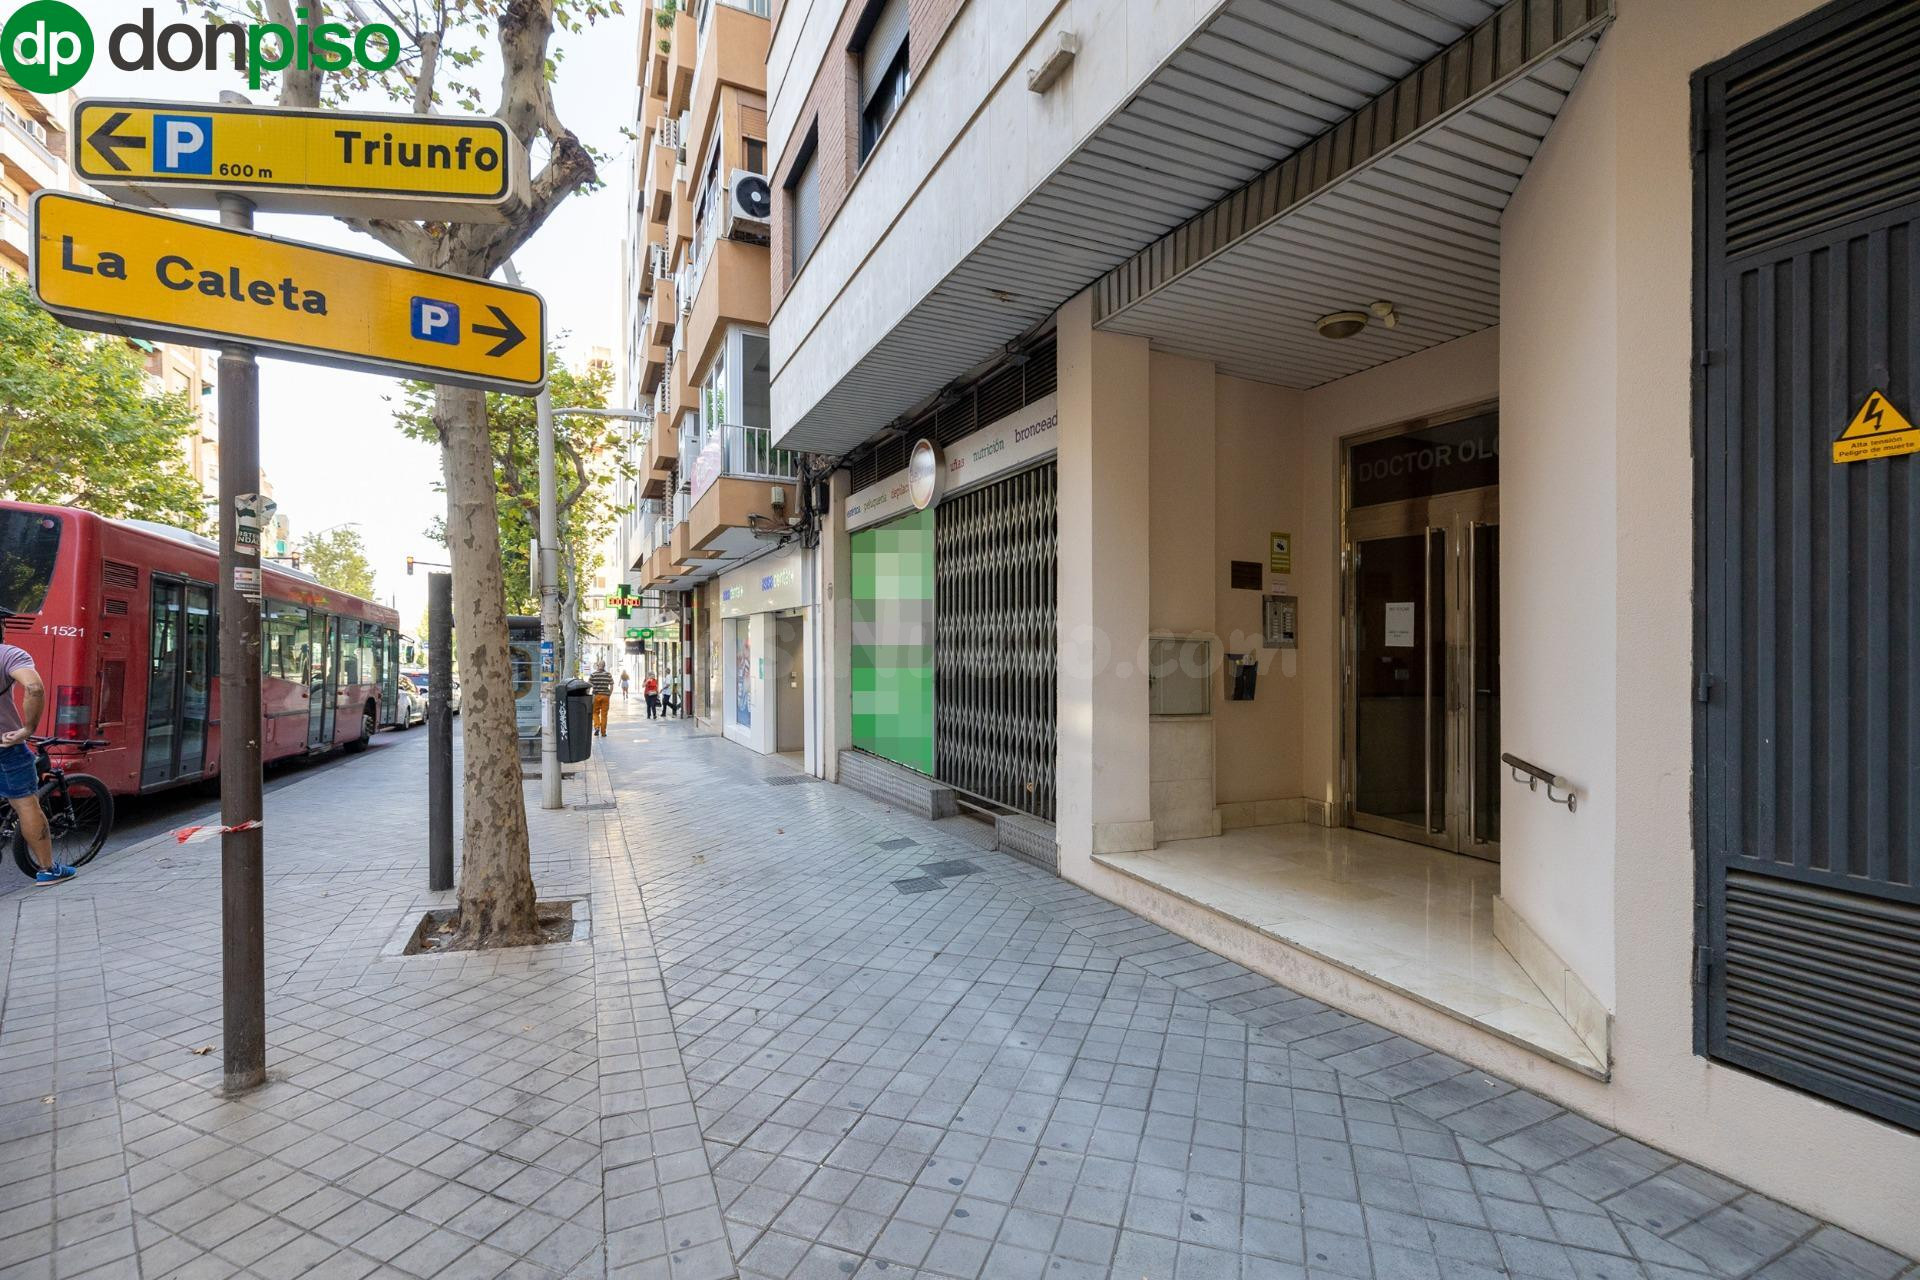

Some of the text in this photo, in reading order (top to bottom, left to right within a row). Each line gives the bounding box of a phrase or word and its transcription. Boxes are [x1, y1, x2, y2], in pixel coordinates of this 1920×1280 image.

[165, 121, 205, 168] P
[334, 130, 499, 171] Triunfo
[219, 163, 273, 179] 600 m
[61, 235, 328, 316] La Caleta
[421, 303, 449, 335] P
[973, 438, 1005, 462] nutrición
[1015, 409, 1058, 443] broncead
[1839, 449, 1868, 457] Peligro
[1883, 442, 1915, 451] muerte
[1871, 436, 1902, 446] tensión
[1359, 445, 1452, 482] DOCTOR
[42, 625, 85, 638] 11521
